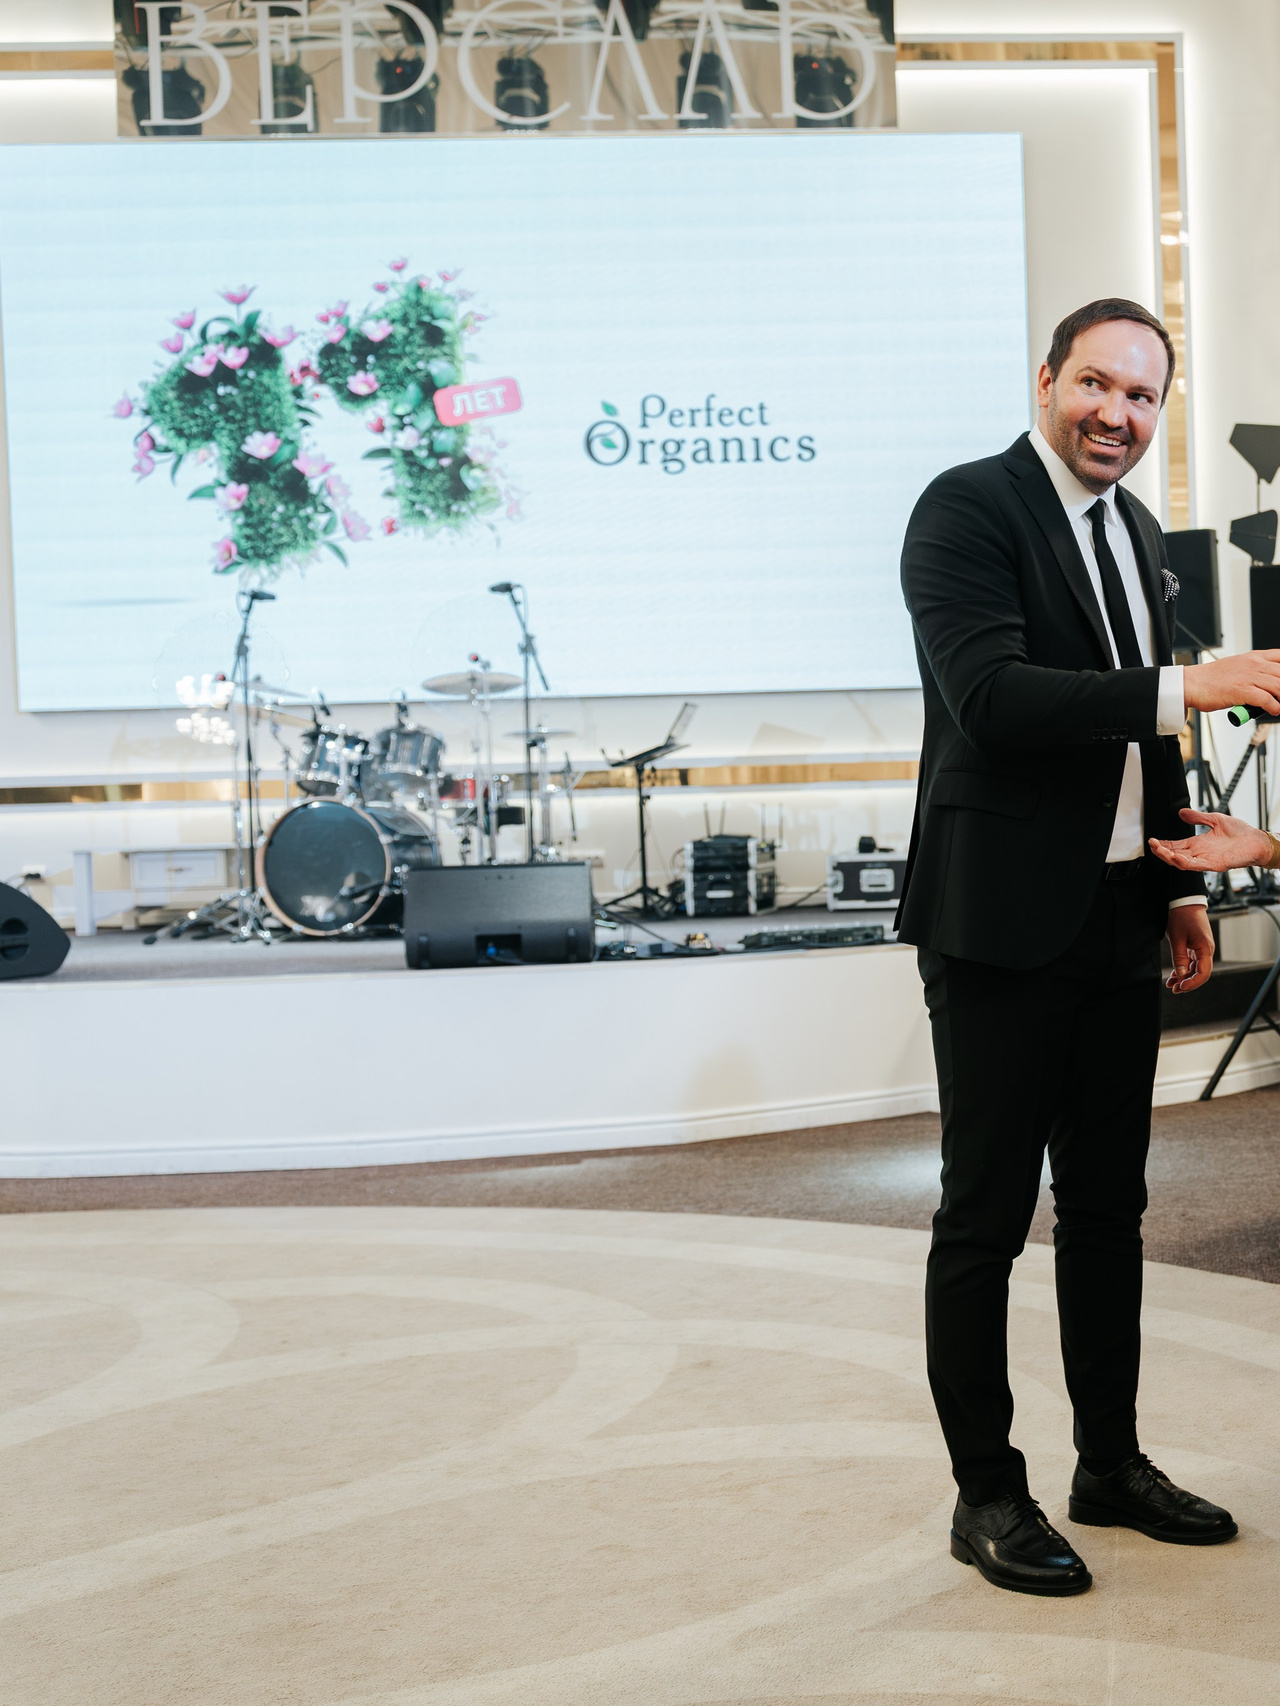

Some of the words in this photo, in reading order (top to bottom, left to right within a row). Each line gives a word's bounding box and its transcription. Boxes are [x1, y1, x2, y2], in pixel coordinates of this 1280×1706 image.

[450, 384, 507, 416] ЛЕТ
[638, 393, 770, 429] Perfect
[584, 419, 817, 475] Organics
